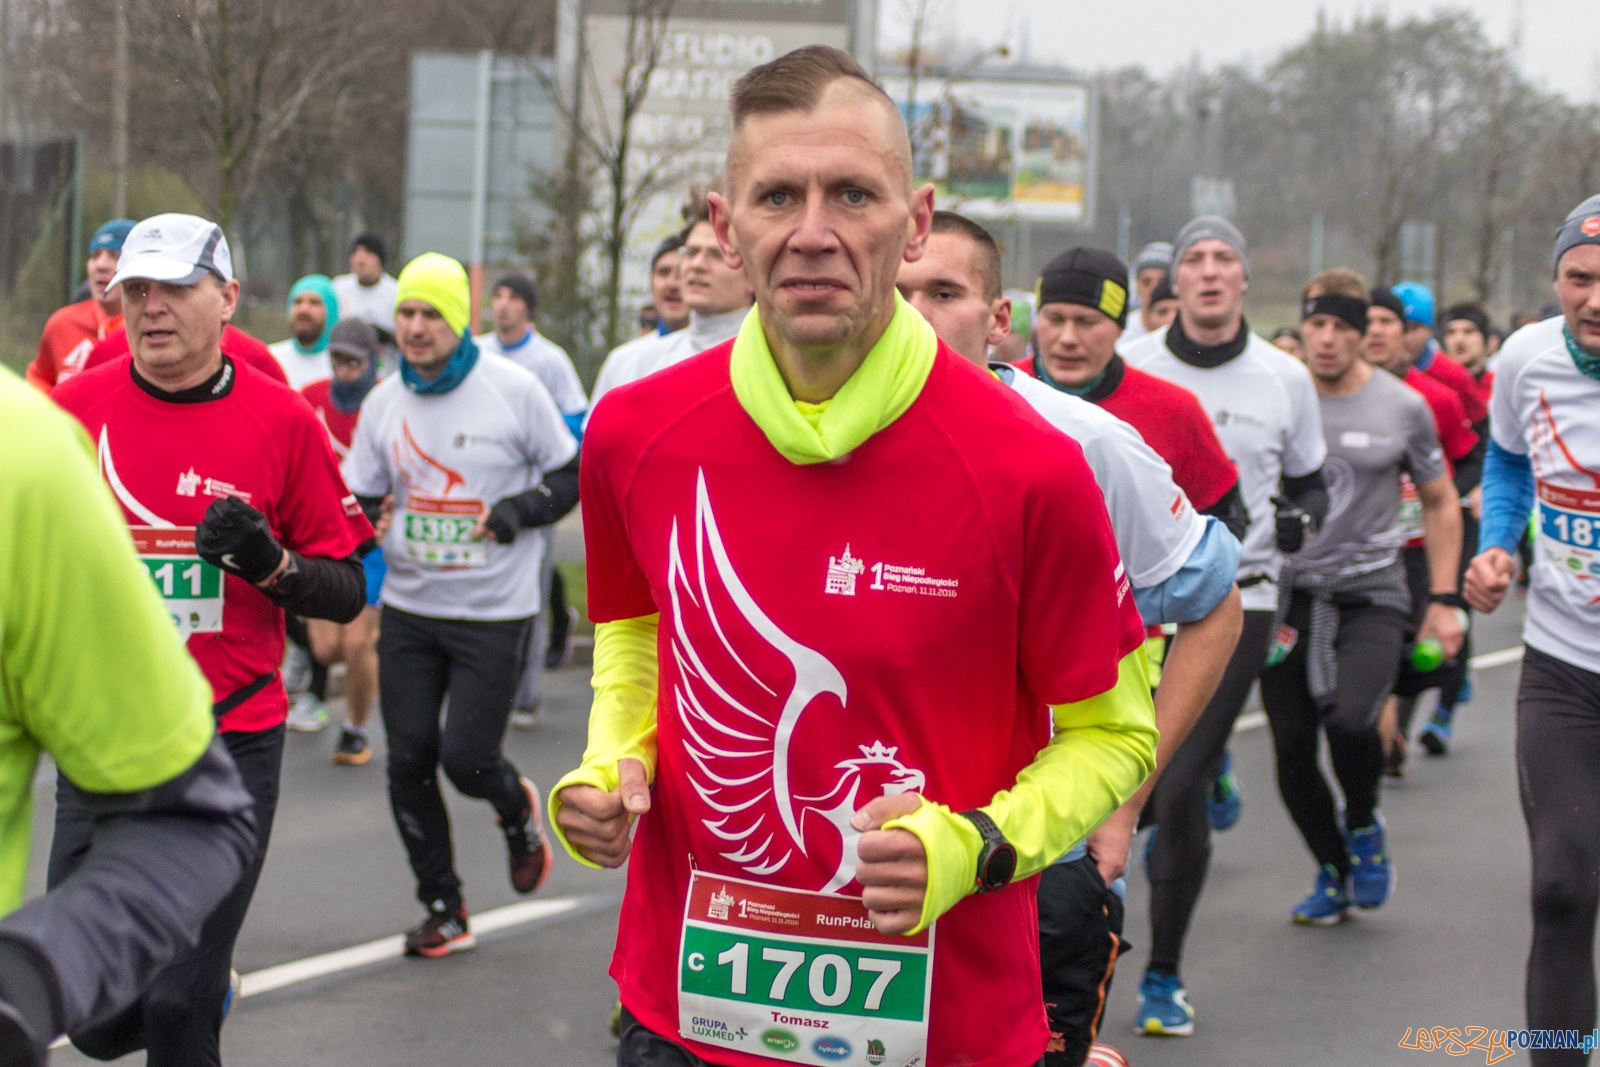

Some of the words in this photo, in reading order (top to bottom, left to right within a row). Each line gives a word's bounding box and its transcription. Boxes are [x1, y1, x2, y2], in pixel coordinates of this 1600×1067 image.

[411, 517, 475, 541] 8392
[884, 564, 925, 576] Poznański
[883, 572, 901, 583] Bieg
[902, 575, 959, 587] Niepodległości
[919, 586, 957, 598] 11.11.2016
[717, 941, 902, 1010] 1707
[692, 1016, 728, 1031] GRUPA
[771, 1011, 829, 1029] Tomasz
[692, 1025, 735, 1041] LUXMED
[767, 1037, 796, 1049] energy
